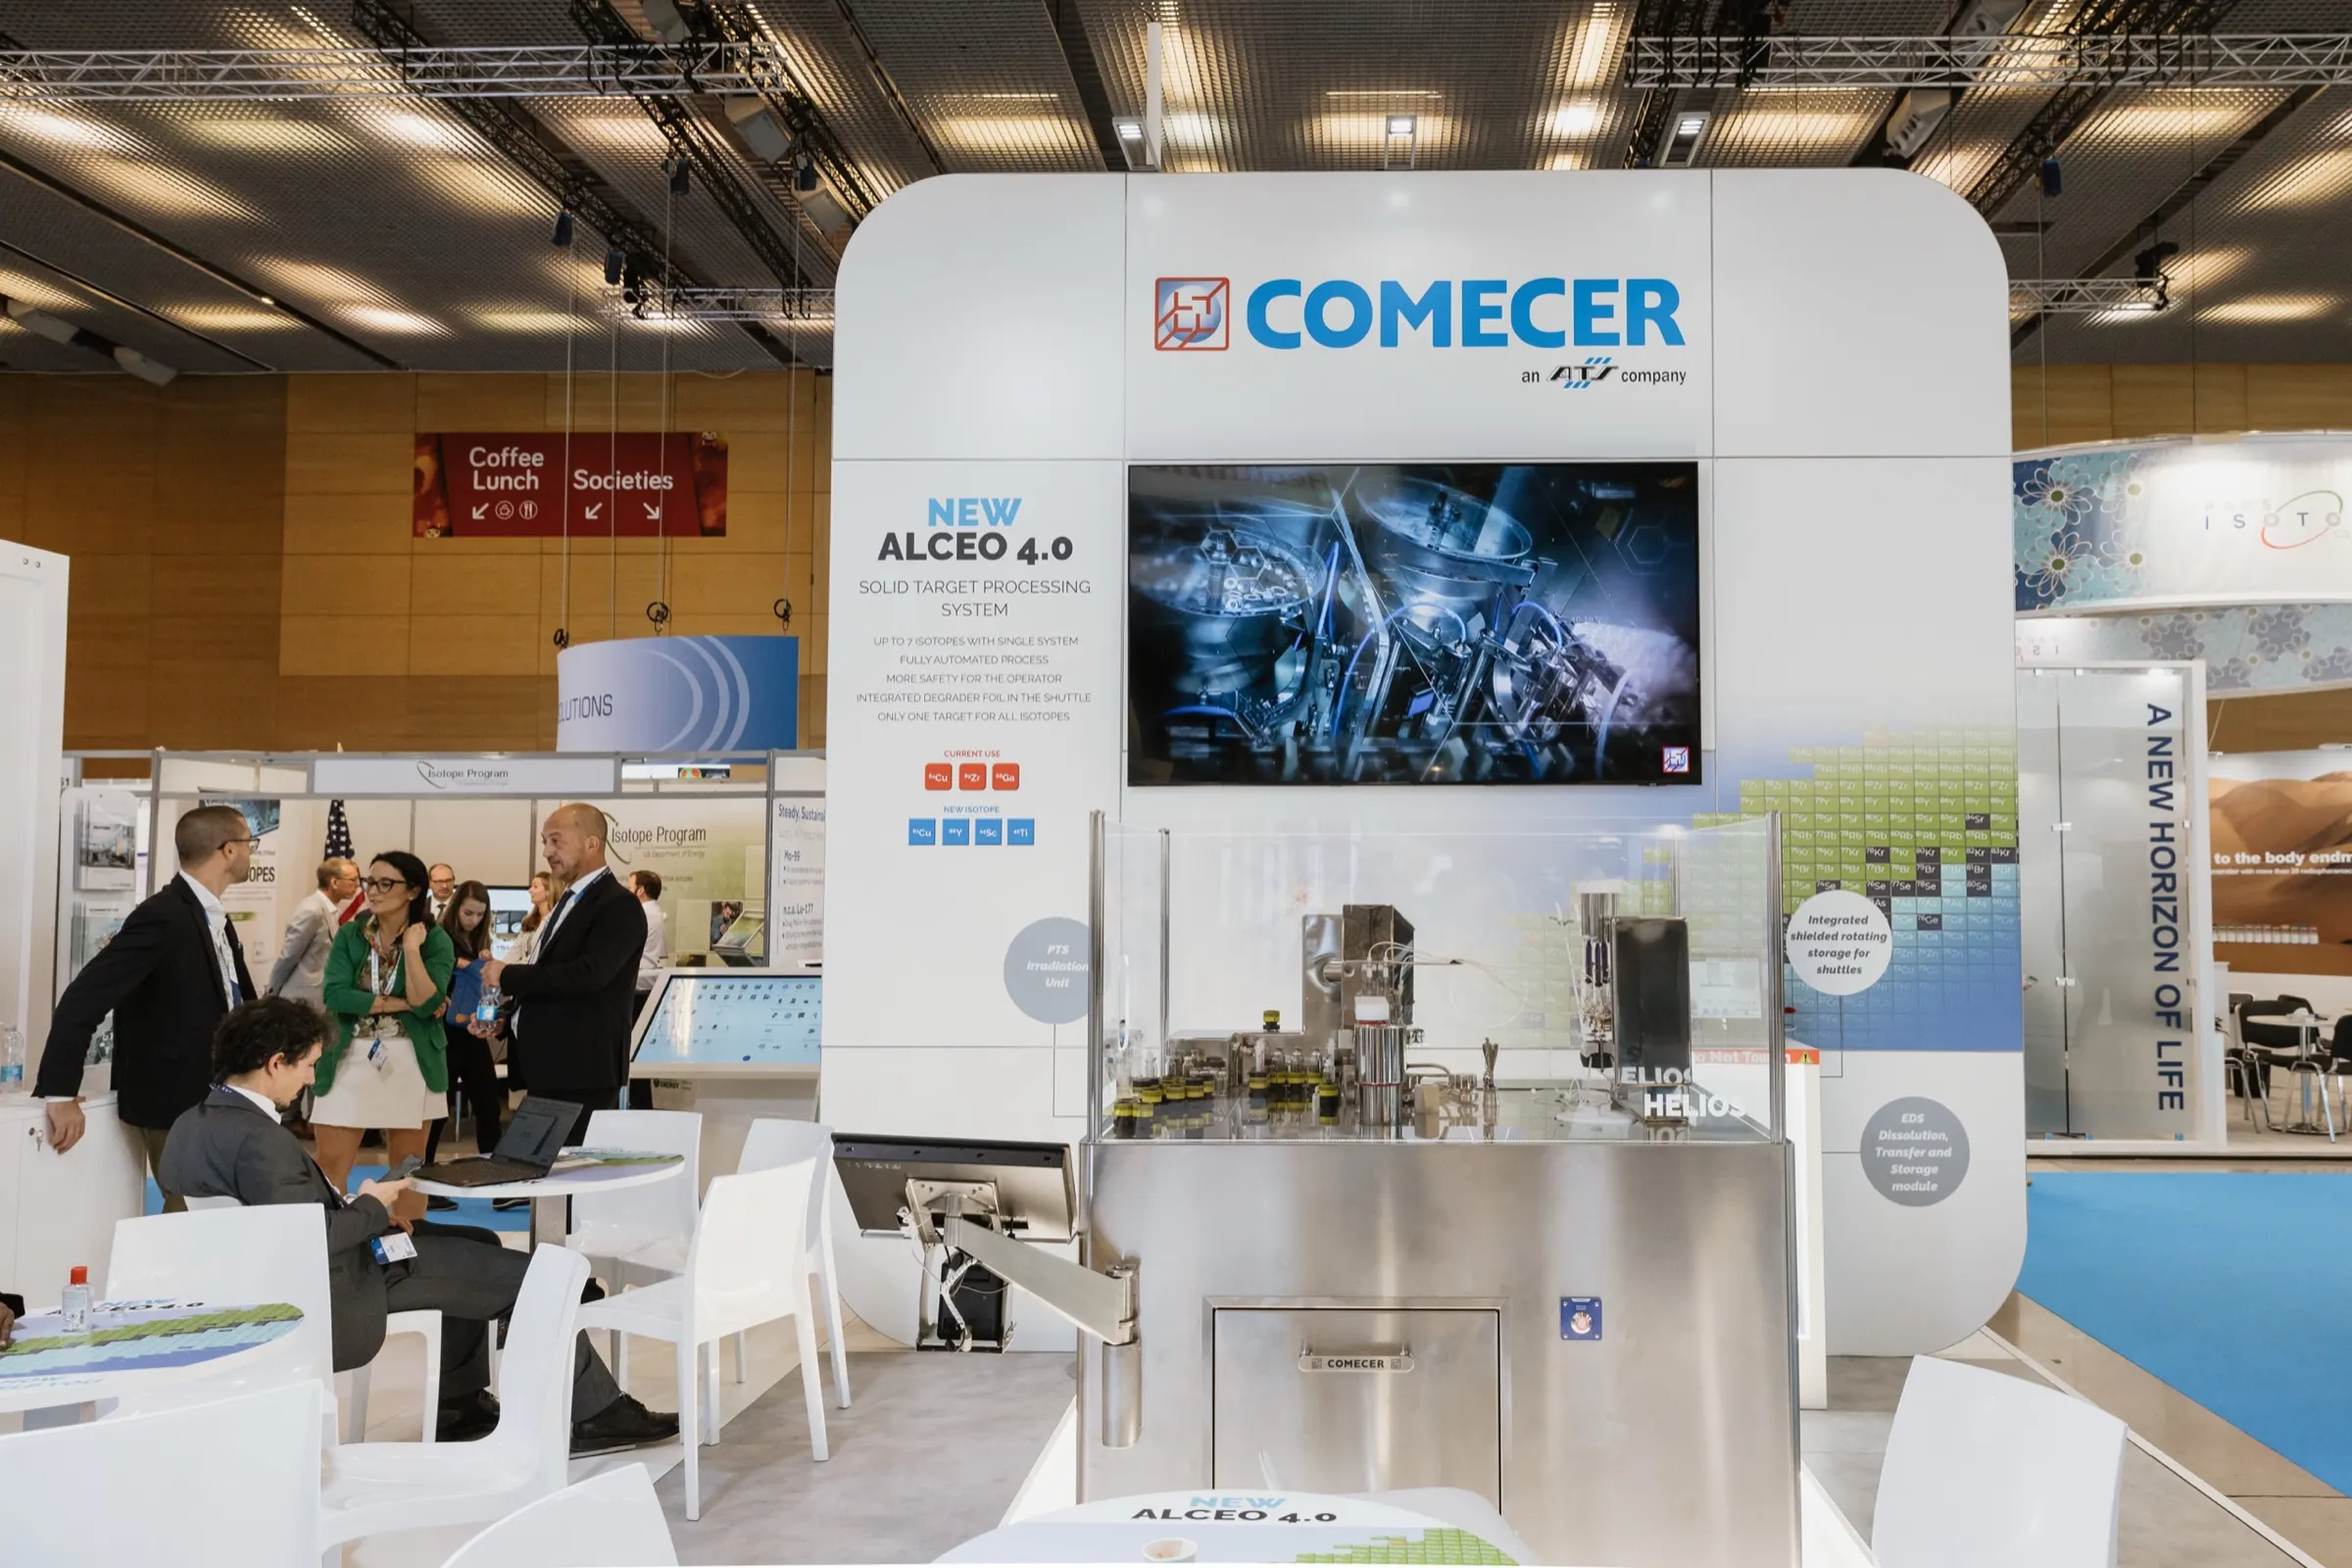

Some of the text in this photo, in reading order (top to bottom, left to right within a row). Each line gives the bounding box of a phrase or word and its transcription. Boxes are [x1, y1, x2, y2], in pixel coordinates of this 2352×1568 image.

[1247, 277, 1686, 349] COMECER
[1521, 370, 1540, 383] an
[1621, 370, 1687, 385] company
[469, 447, 544, 467] Coffee
[472, 468, 539, 490] Lunch
[573, 468, 673, 490] Societies
[928, 498, 1022, 526] NEW
[877, 532, 1073, 565] ALCEO 4.0
[858, 580, 1091, 595] SOLID TARGET PROCESSING
[941, 603, 1008, 617] SYSTEM
[873, 636, 1079, 647] UP TO 7 ISOTOPES WITH SINGLE SYSTEM
[900, 655, 1050, 665] FULLY AUTOMATED PROCESS
[886, 673, 1062, 684] MORE SAFETY FOR THE OPERATOR
[857, 693, 1092, 704] INTEGRATED DEGRADER FOIL IN THE SHUTTLE
[878, 711, 1070, 722] ONLY ONE TARGET FOR ALL ISOTOPES
[944, 750, 1001, 759] CURRENT USE
[428, 768, 509, 780] Isotope Program
[944, 805, 1000, 814] NEW ISOTOPE
[612, 825, 707, 846] Isotope Program
[2214, 853, 2231, 864] to
[2234, 852, 2261, 864] the
[2265, 851, 2305, 866] body
[2147, 703, 2184, 1110] A NEW HORIZON OF LIFE
[1808, 915, 1869, 927] Integrated
[1790, 931, 1887, 944] shielded rotating
[1047, 944, 1070, 955] PTS
[1807, 948, 1871, 959] storage for
[1026, 960, 1089, 971] Irradiation
[1817, 964, 1862, 975] shuttles
[1045, 976, 1070, 988] Unit
[1710, 1052, 1739, 1063] Not
[1644, 1094, 1746, 1117] HELIOS
[1901, 1113, 1925, 1124] EDS
[1879, 1130, 1948, 1142] Dissolution,
[1875, 1147, 1952, 1160] Transfer and
[1889, 1163, 1939, 1177] Storage
[1891, 1181, 1938, 1192] module
[1327, 1359, 1385, 1369] COMECER
[1189, 1496, 1287, 1509] NEW
[1131, 1508, 1338, 1523] ALCEO 4.0
